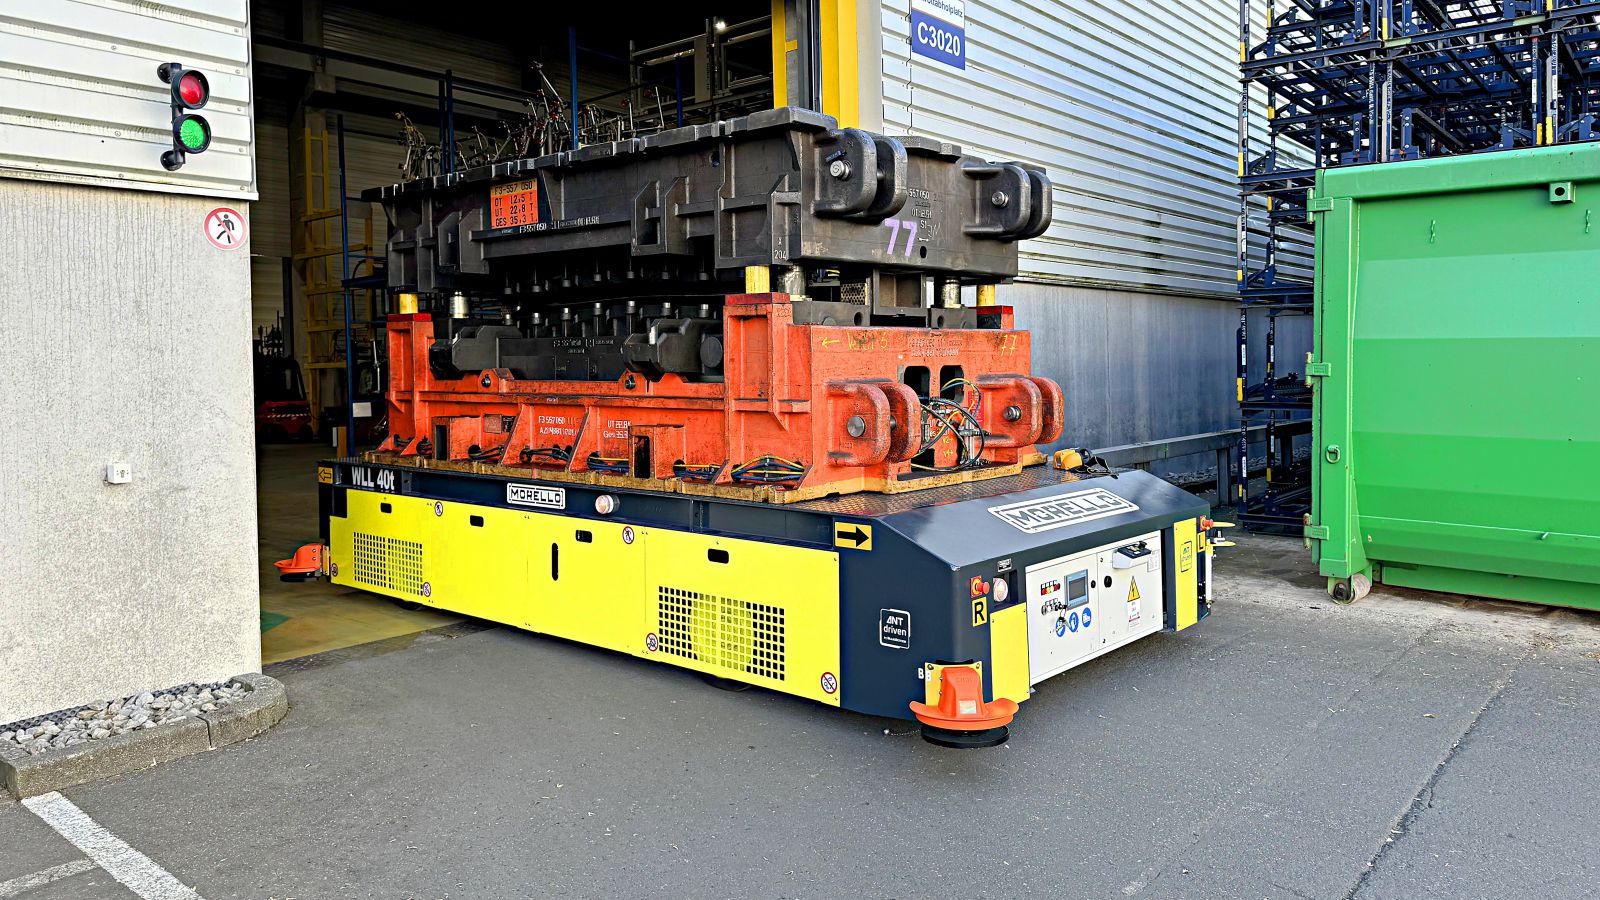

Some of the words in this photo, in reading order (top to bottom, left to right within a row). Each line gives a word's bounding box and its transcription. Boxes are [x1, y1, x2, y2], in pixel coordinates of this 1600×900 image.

[917, 21, 961, 57] C3020
[494, 183, 518, 195] F3-557
[494, 197, 503, 207] OT
[510, 193, 526, 204] 12,5
[494, 207, 503, 217] UT
[510, 204, 526, 214] 22,8
[495, 217, 507, 227] GES
[510, 214, 527, 225] 35,3
[884, 217, 918, 257] 77
[351, 465, 375, 488] WLL
[376, 468, 395, 491] 40t
[510, 488, 561, 503] MORELLO
[1005, 494, 1123, 526] MORELLO
[974, 601, 985, 624] R
[886, 615, 904, 626] ANT
[883, 624, 907, 637] driven
